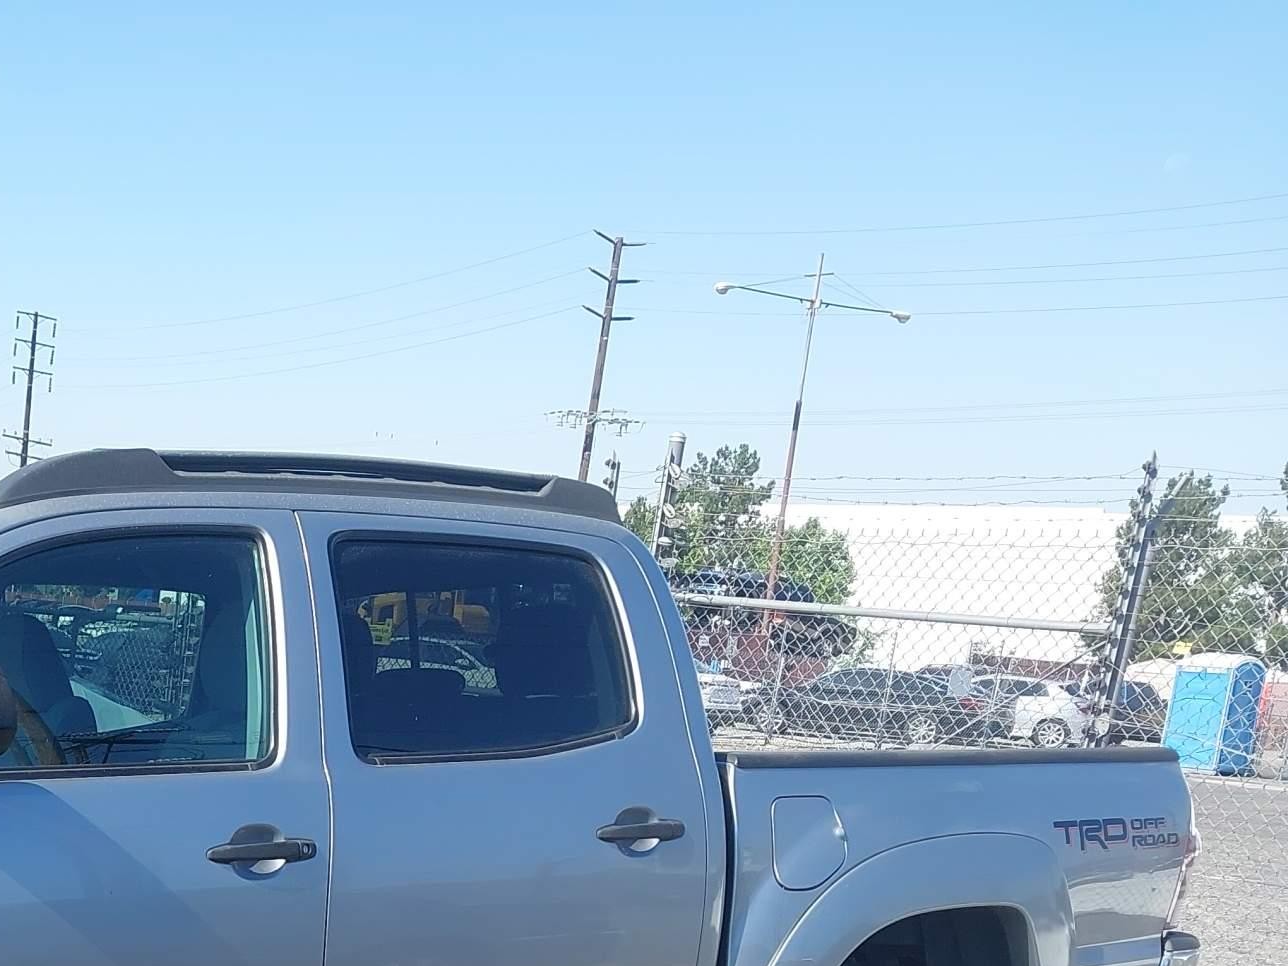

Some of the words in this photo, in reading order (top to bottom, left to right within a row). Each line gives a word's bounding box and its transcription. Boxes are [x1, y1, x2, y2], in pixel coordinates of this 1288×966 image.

[1131, 817, 1166, 831] OFF
[1052, 817, 1129, 851] TRD
[1132, 832, 1180, 849] ROAD
